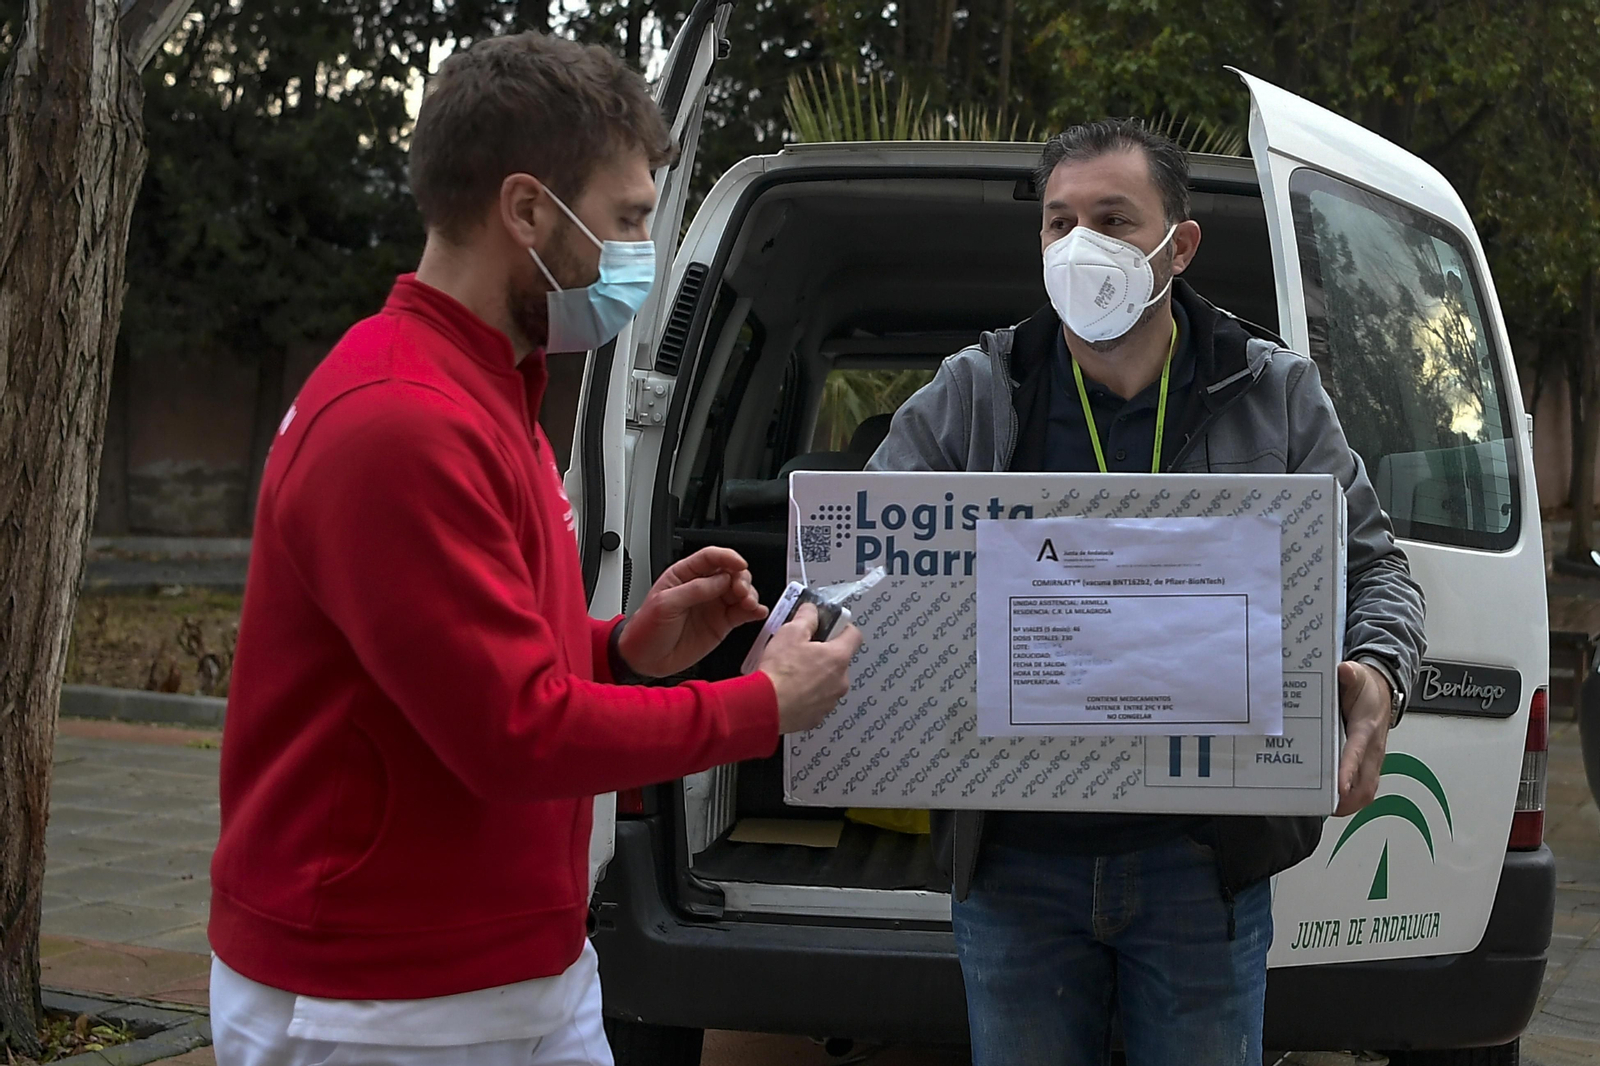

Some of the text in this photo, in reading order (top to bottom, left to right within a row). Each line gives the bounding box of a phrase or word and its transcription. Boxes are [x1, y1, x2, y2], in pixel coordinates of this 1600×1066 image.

[855, 535, 977, 577] Phar
[1082, 578, 1111, 588] (vacuna
[1154, 578, 1163, 586] de
[1417, 665, 1506, 710] Berlingo
[1265, 738, 1294, 748] MUY
[1256, 751, 1303, 764] FRÁGIL
[1290, 920, 1341, 950] JUNTA
[1346, 918, 1367, 946] DE
